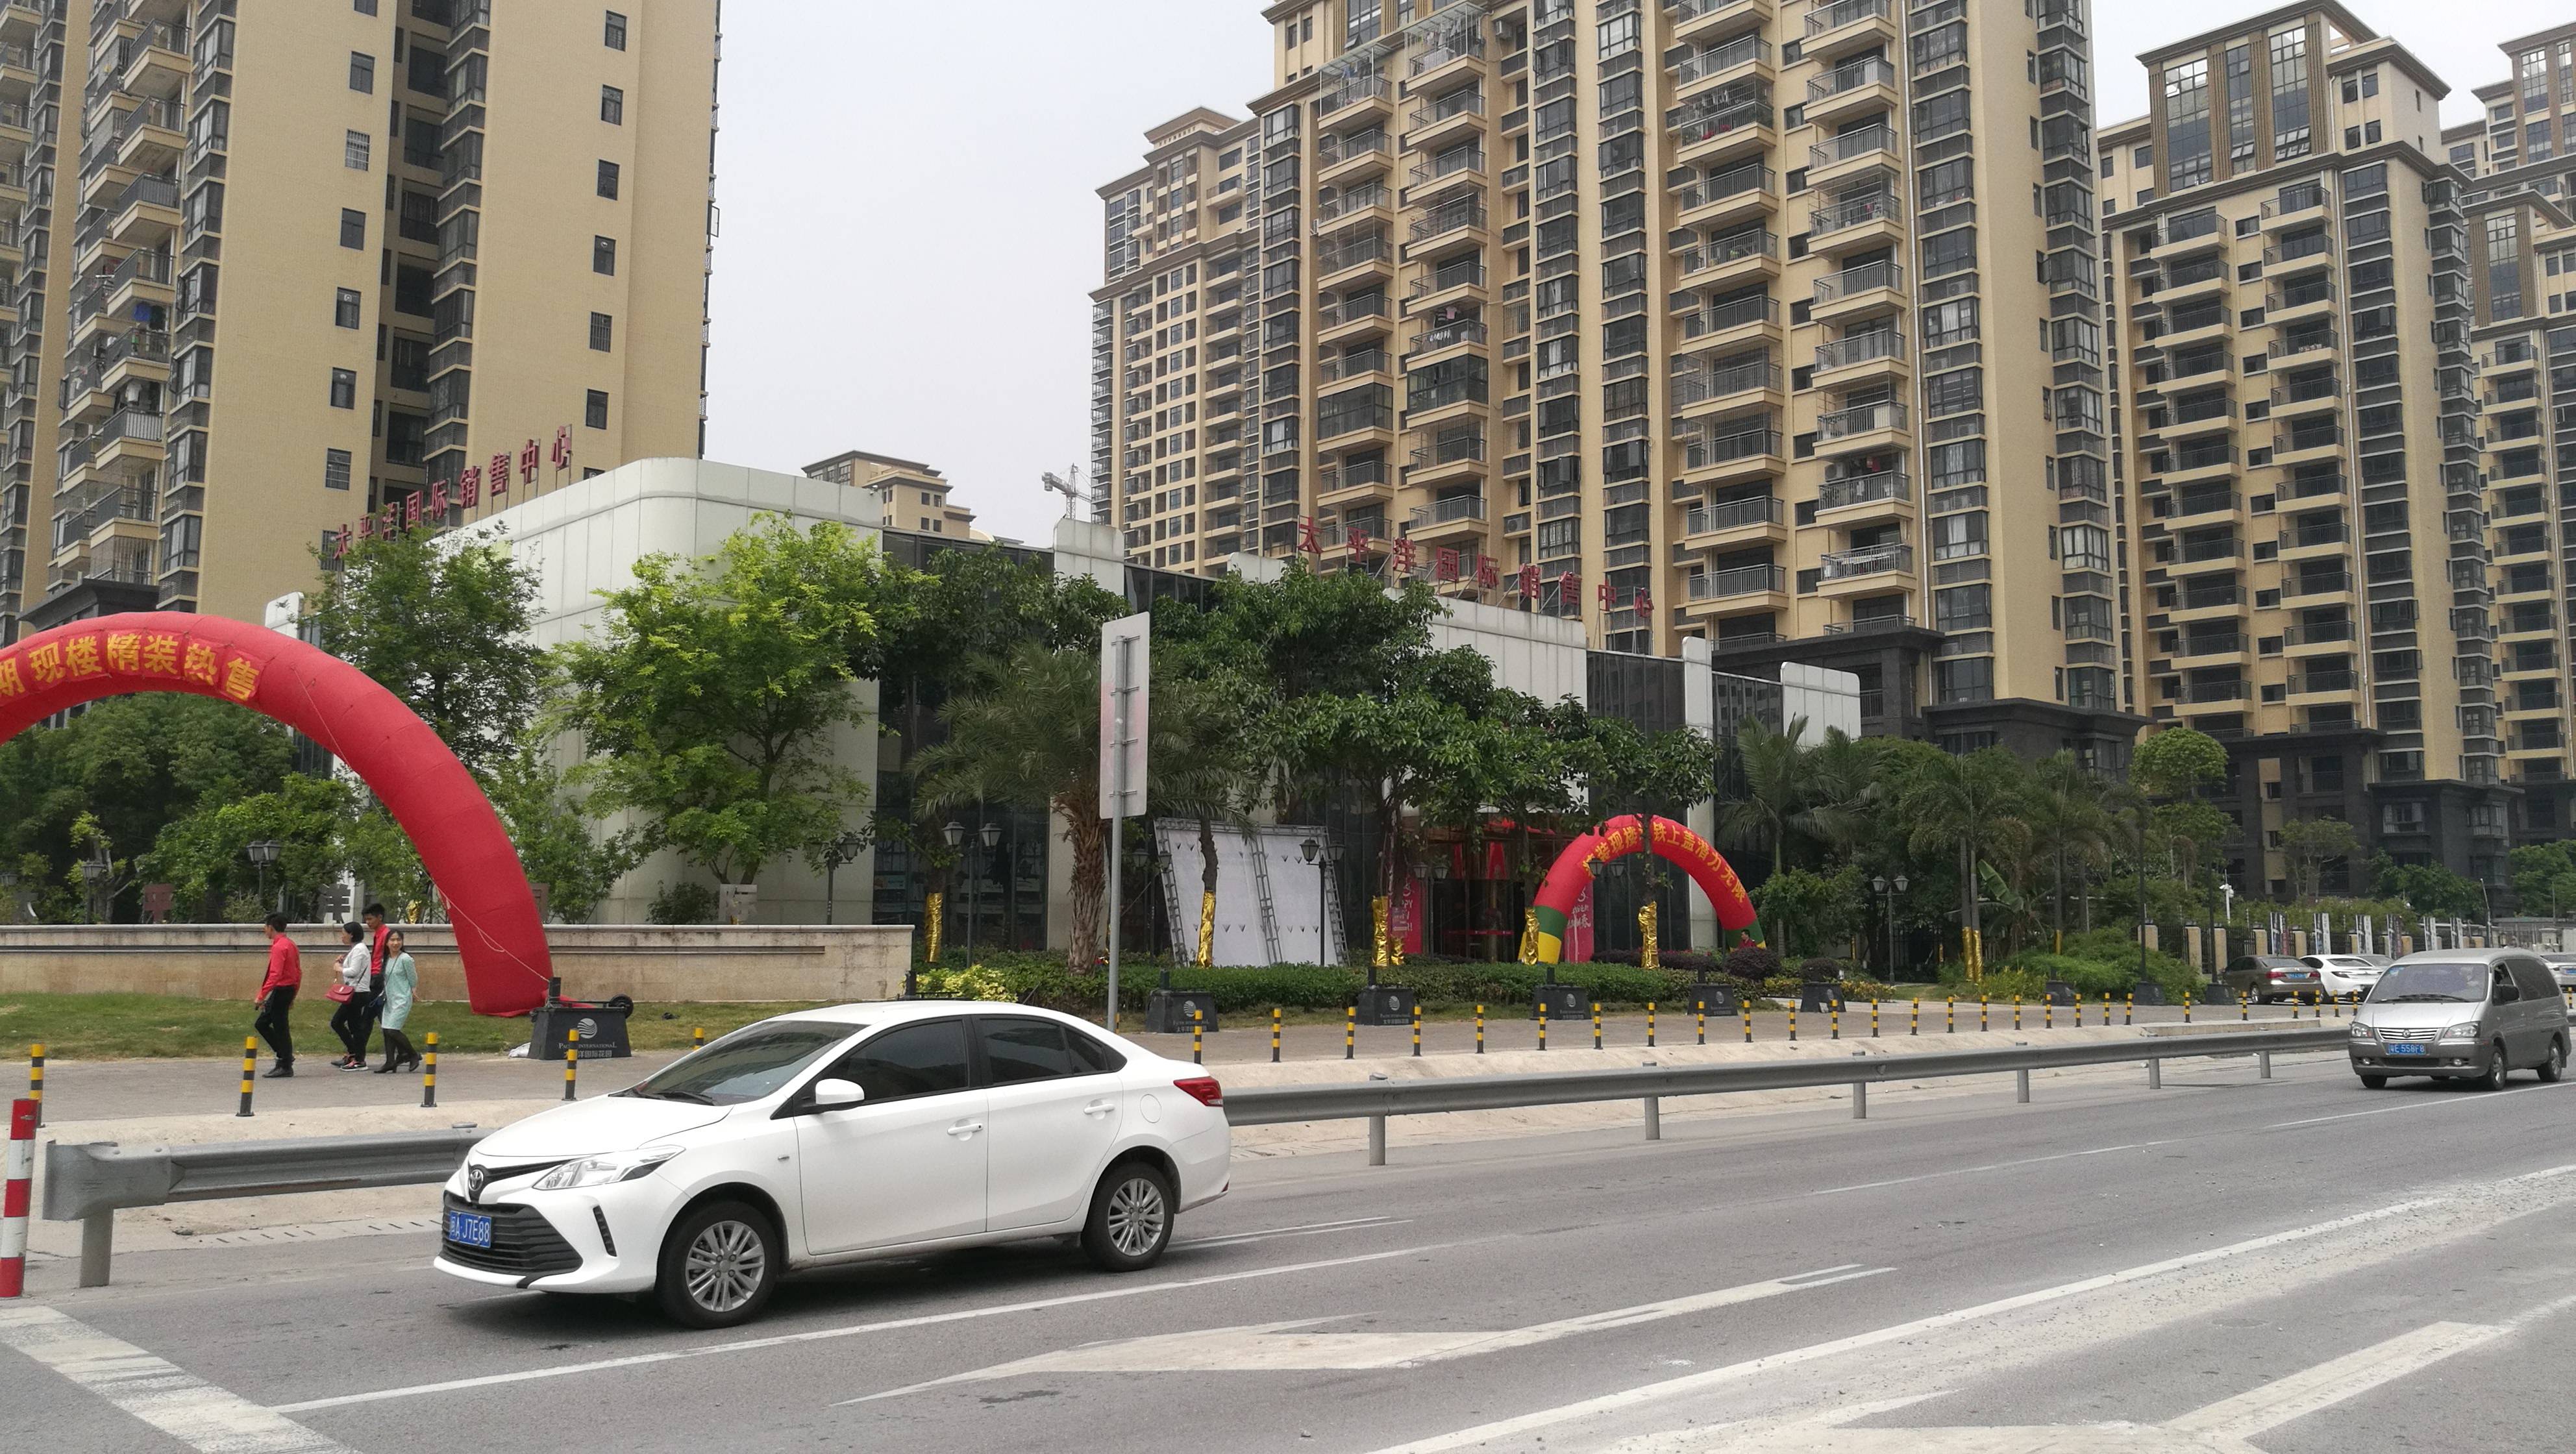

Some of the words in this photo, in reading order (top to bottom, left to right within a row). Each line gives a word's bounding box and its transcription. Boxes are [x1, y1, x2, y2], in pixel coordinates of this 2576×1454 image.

[333, 426, 571, 560] 太平洋国际销售中心
[1298, 516, 1654, 616] 太平洋国际销售中心
[1582, 821, 1746, 903] 装现楼铁上盖潜力无限
